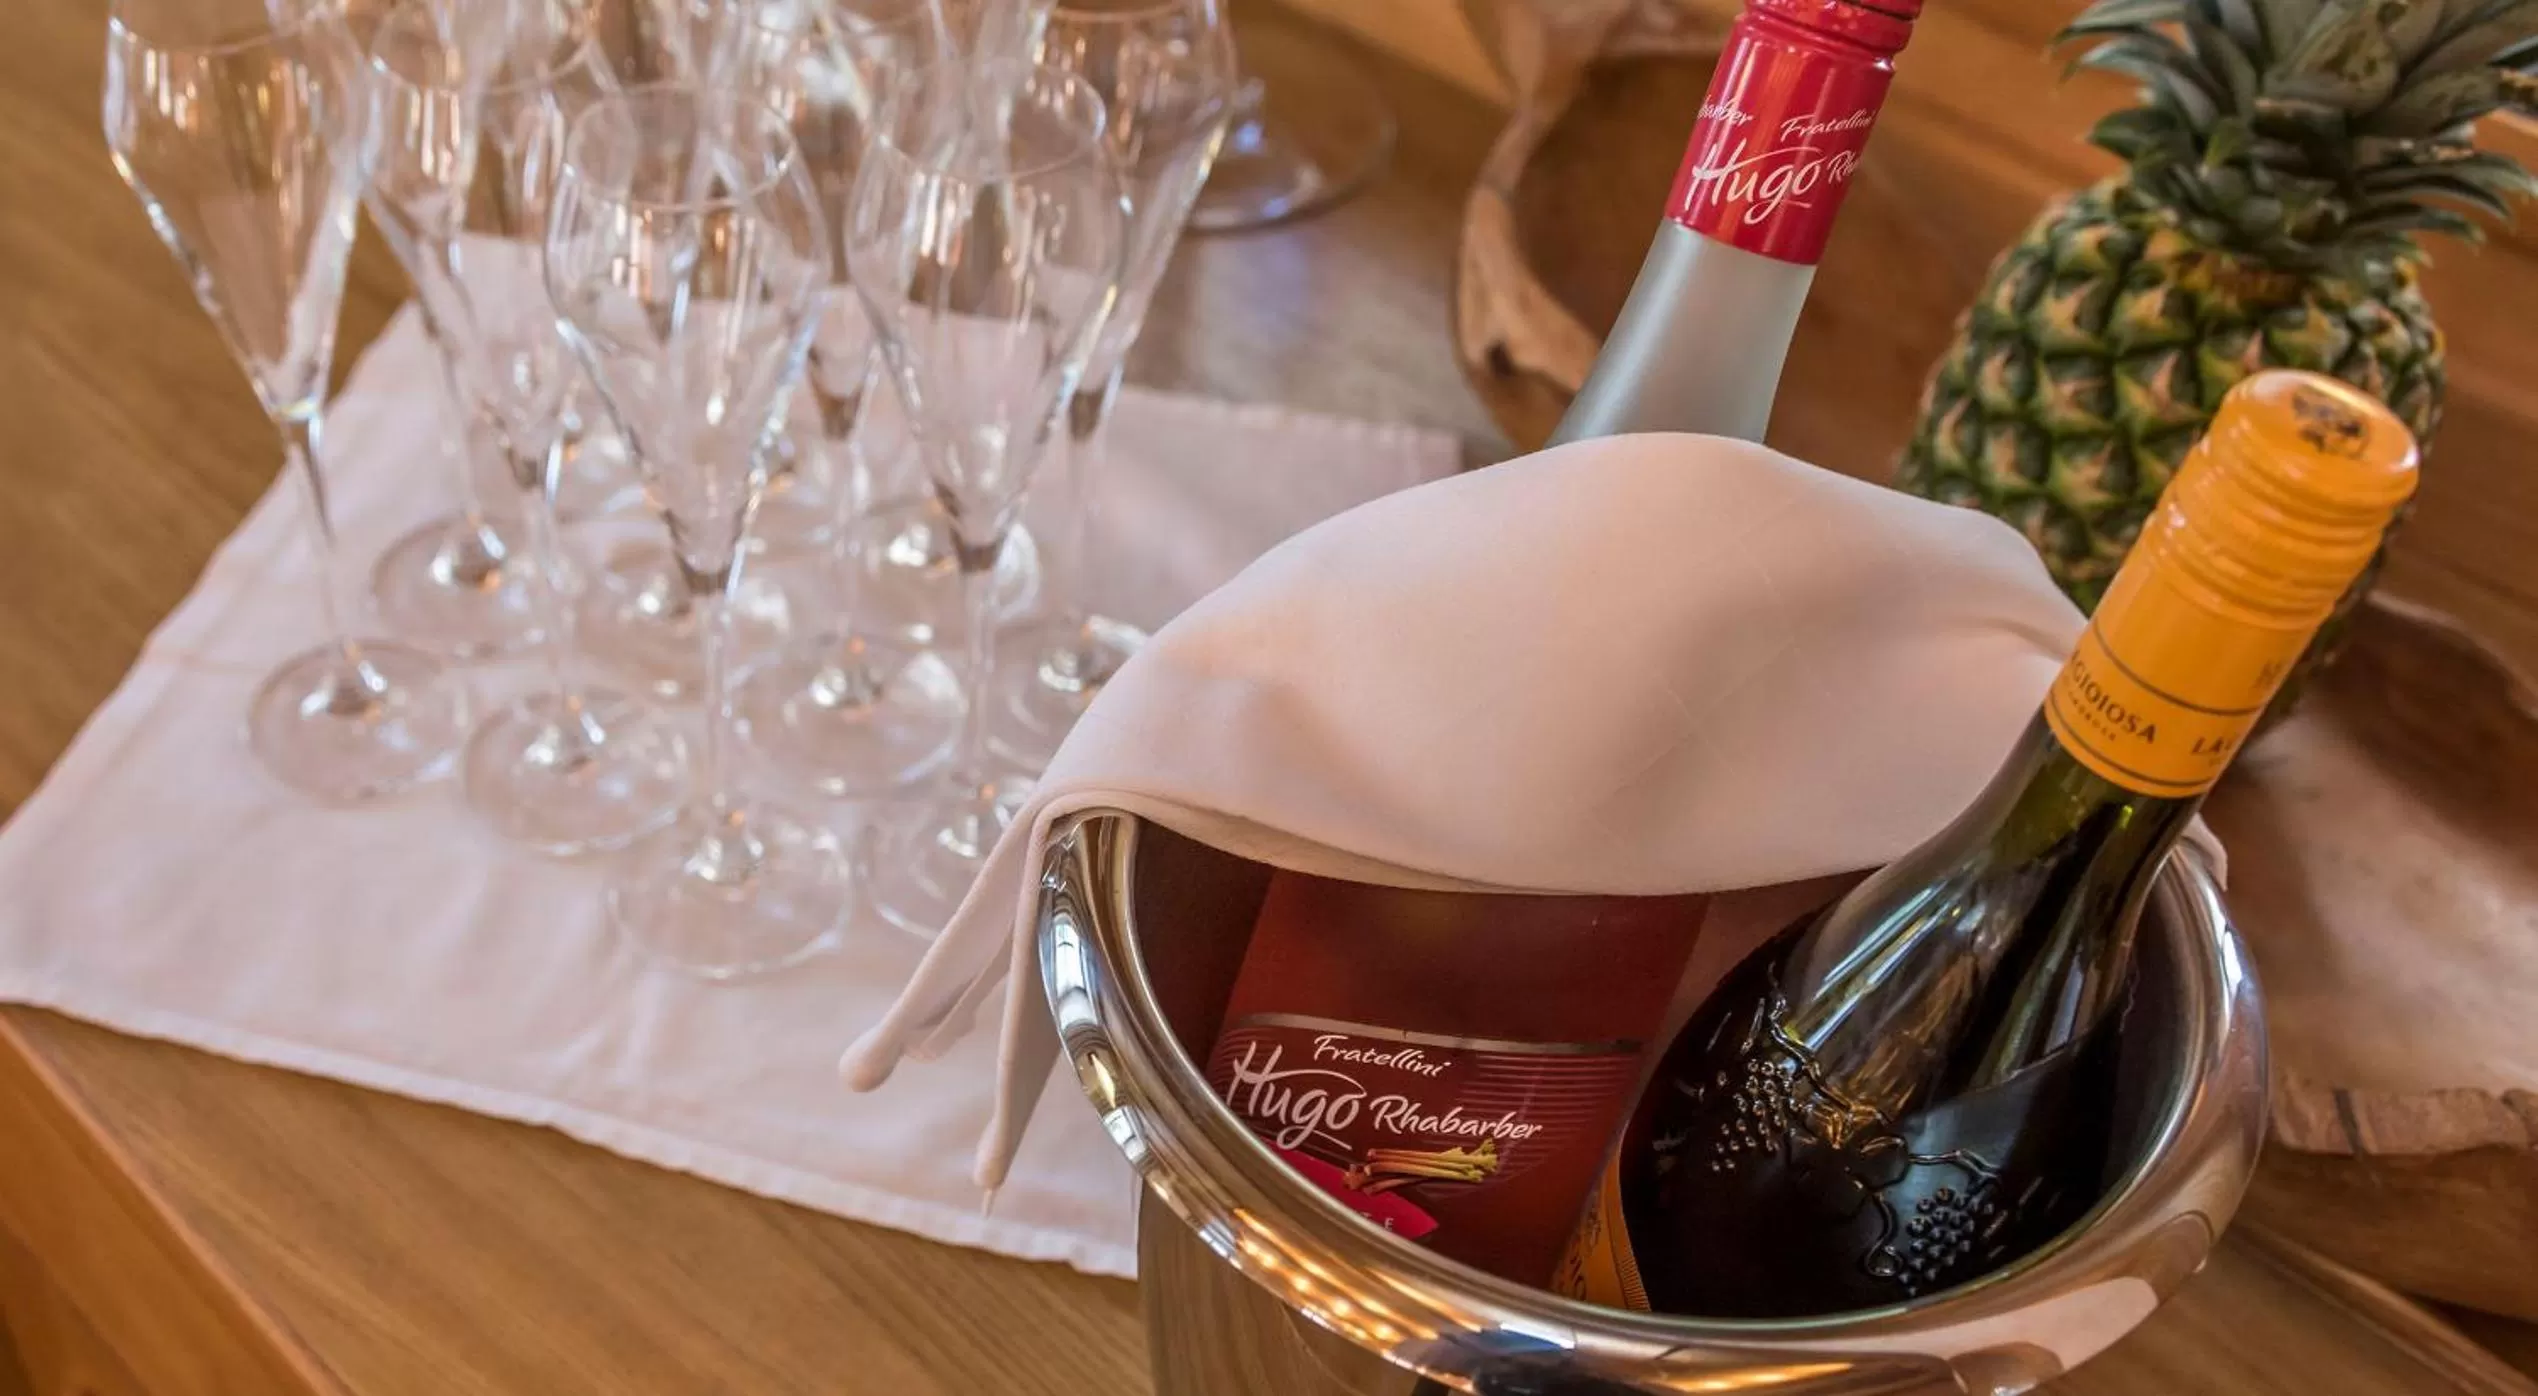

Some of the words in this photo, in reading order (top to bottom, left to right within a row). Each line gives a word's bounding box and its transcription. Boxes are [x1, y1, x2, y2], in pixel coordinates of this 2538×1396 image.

[1684, 137, 1828, 225] Hugo
[1226, 1040, 1368, 1151] Hugo
[1369, 1094, 1544, 1139] Rhabarber
[1313, 1034, 1453, 1077] Fratellini
